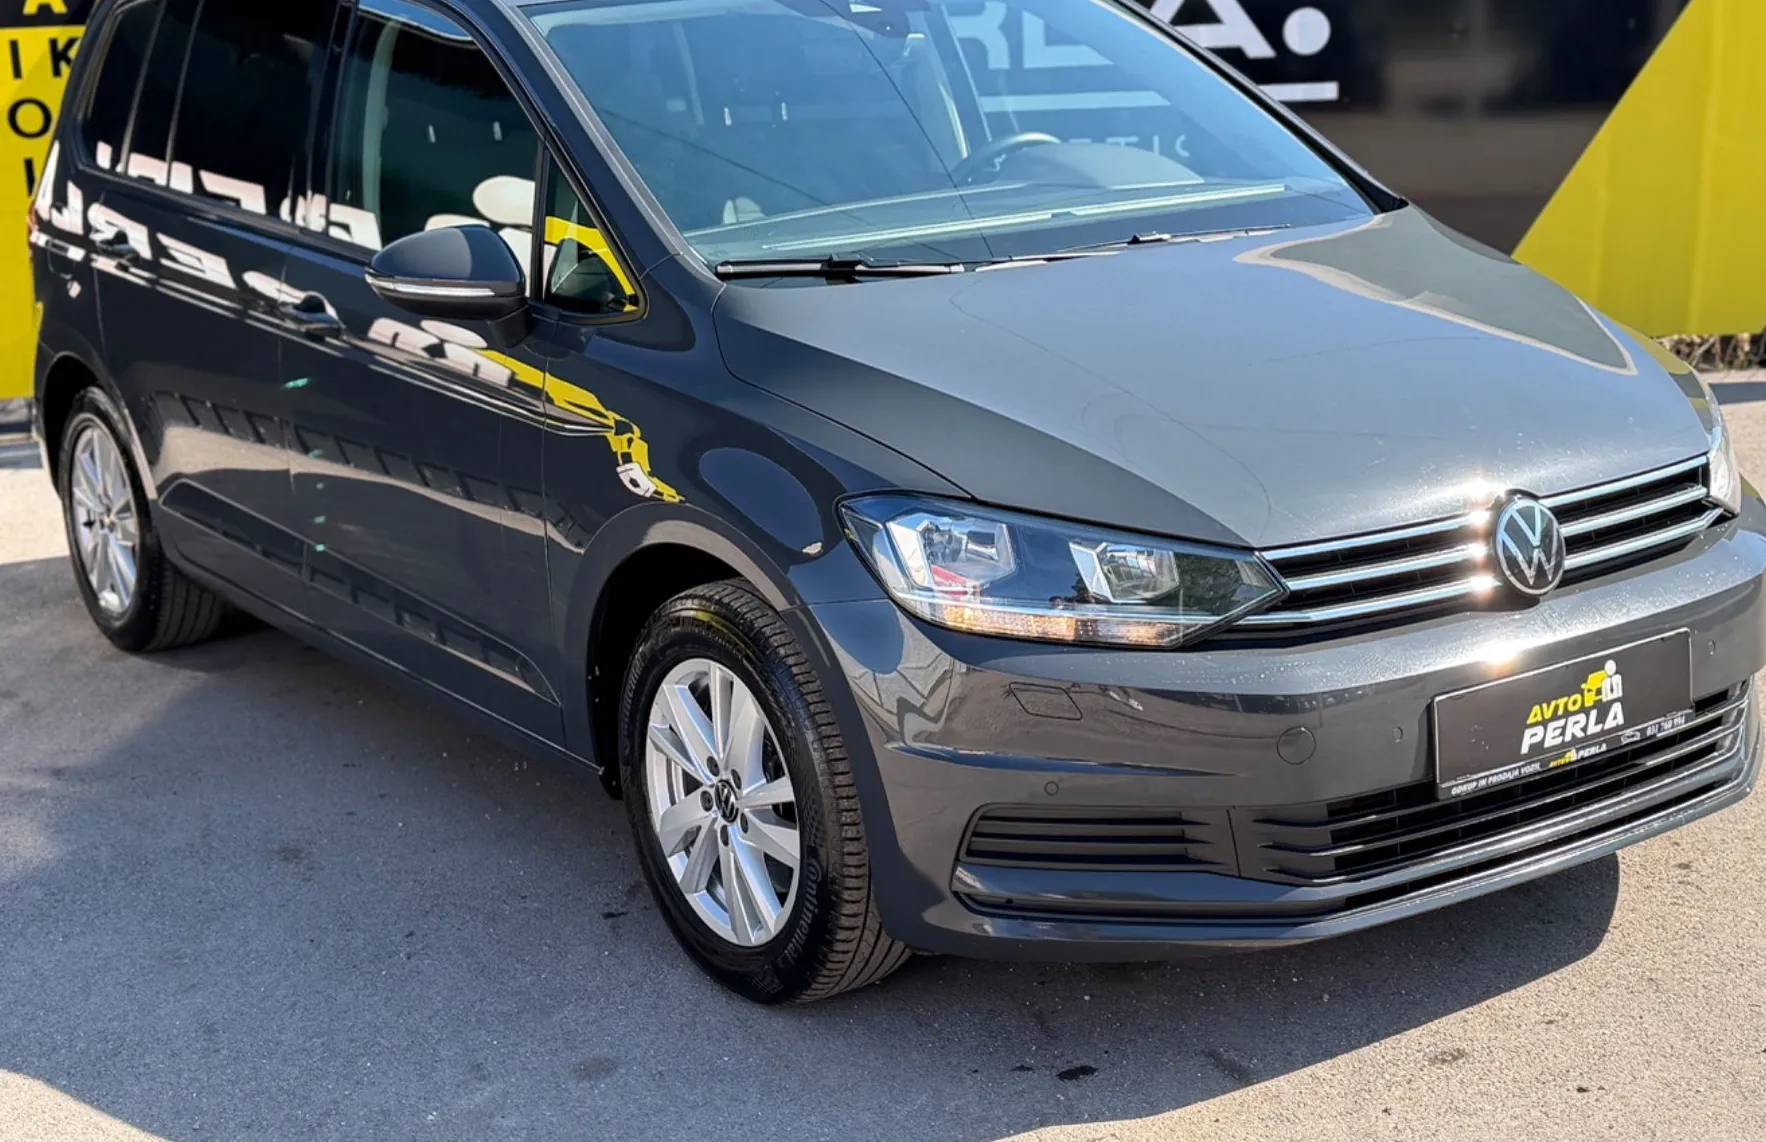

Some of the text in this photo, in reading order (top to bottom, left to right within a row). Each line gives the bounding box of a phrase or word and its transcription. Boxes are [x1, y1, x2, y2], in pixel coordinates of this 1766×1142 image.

[1526, 693, 1583, 725] AVTO
[1520, 701, 1625, 755] PERLA
[1576, 742, 1607, 760] PERLA
